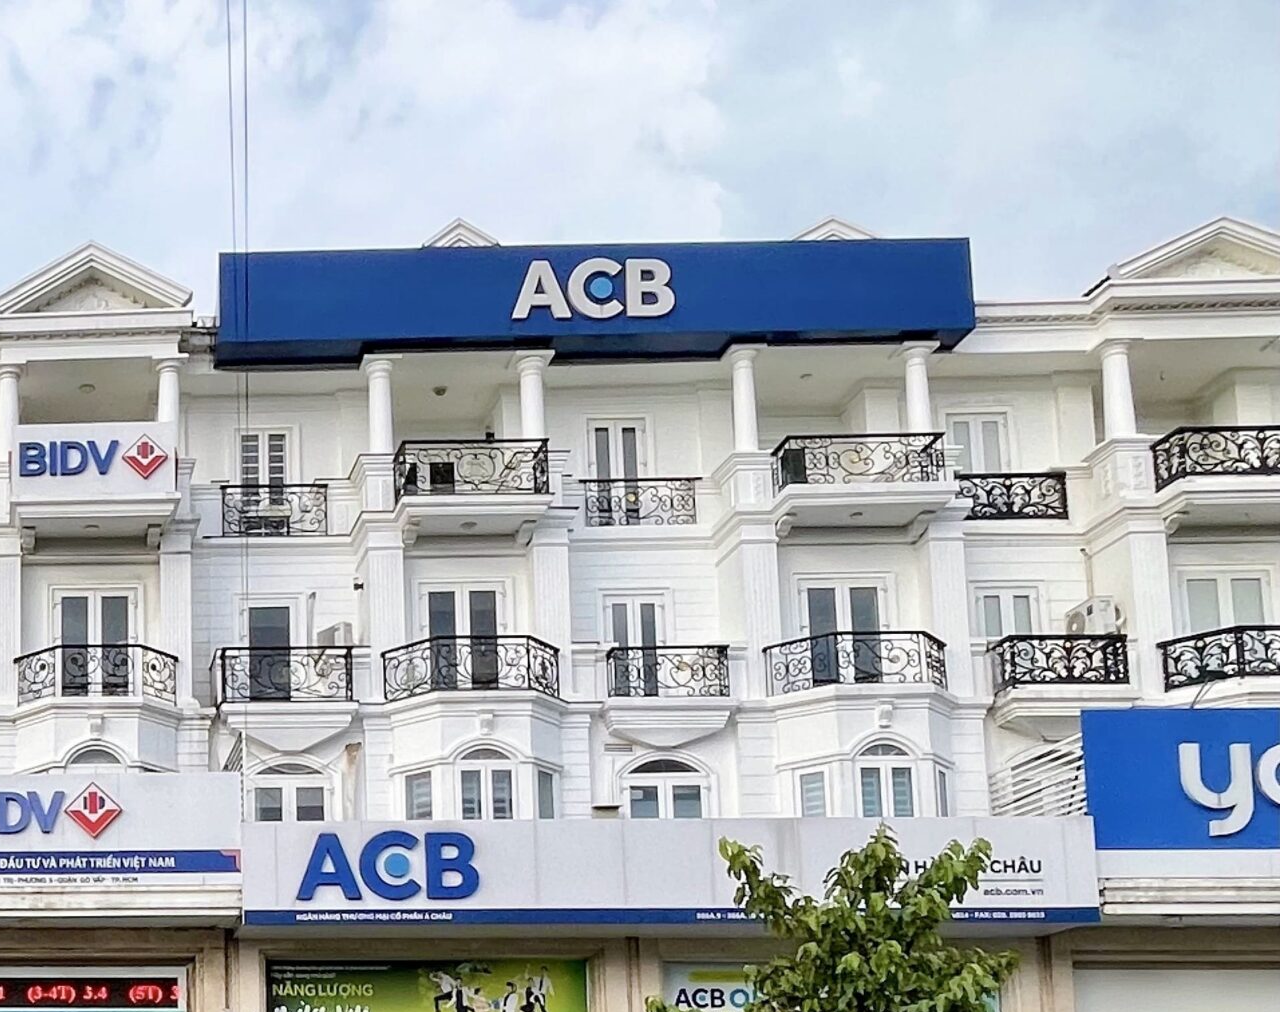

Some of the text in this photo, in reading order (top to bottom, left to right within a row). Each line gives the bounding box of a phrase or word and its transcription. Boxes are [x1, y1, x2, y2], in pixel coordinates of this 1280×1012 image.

[511, 258, 677, 319] ACB
[19, 440, 119, 477] BIDV
[148, 856, 175, 868] NAM
[296, 830, 480, 901] ACB
[990, 856, 1042, 874] CHÂU
[983, 888, 1044, 896] acb.com.vn
[27, 984, 76, 1004] (3-4T)
[83, 985, 108, 1000] 3.4
[129, 985, 163, 1004] (5T)
[272, 981, 374, 999] NĂNG LƯỢNG
[675, 988, 726, 1009] ACB
